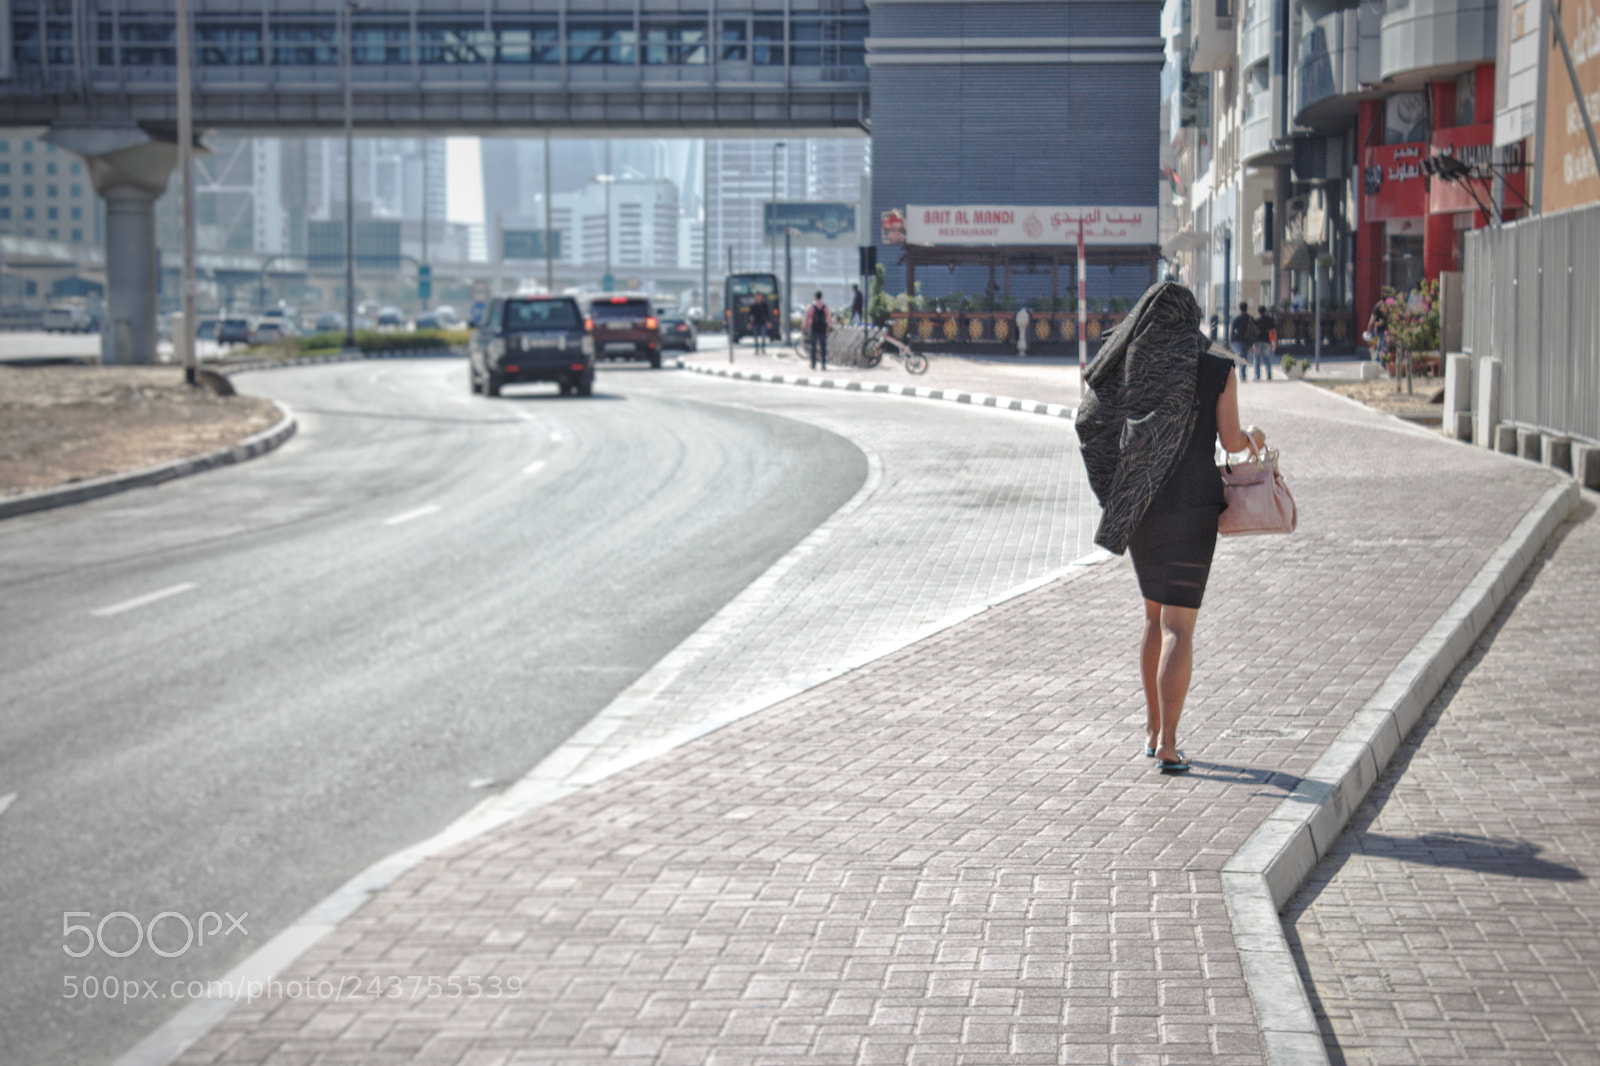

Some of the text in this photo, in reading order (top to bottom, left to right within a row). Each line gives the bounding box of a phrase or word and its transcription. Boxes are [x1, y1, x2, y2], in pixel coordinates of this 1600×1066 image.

[923, 209, 1014, 225] BAIT AL MANDI
[938, 227, 999, 237] RESTAURANT
